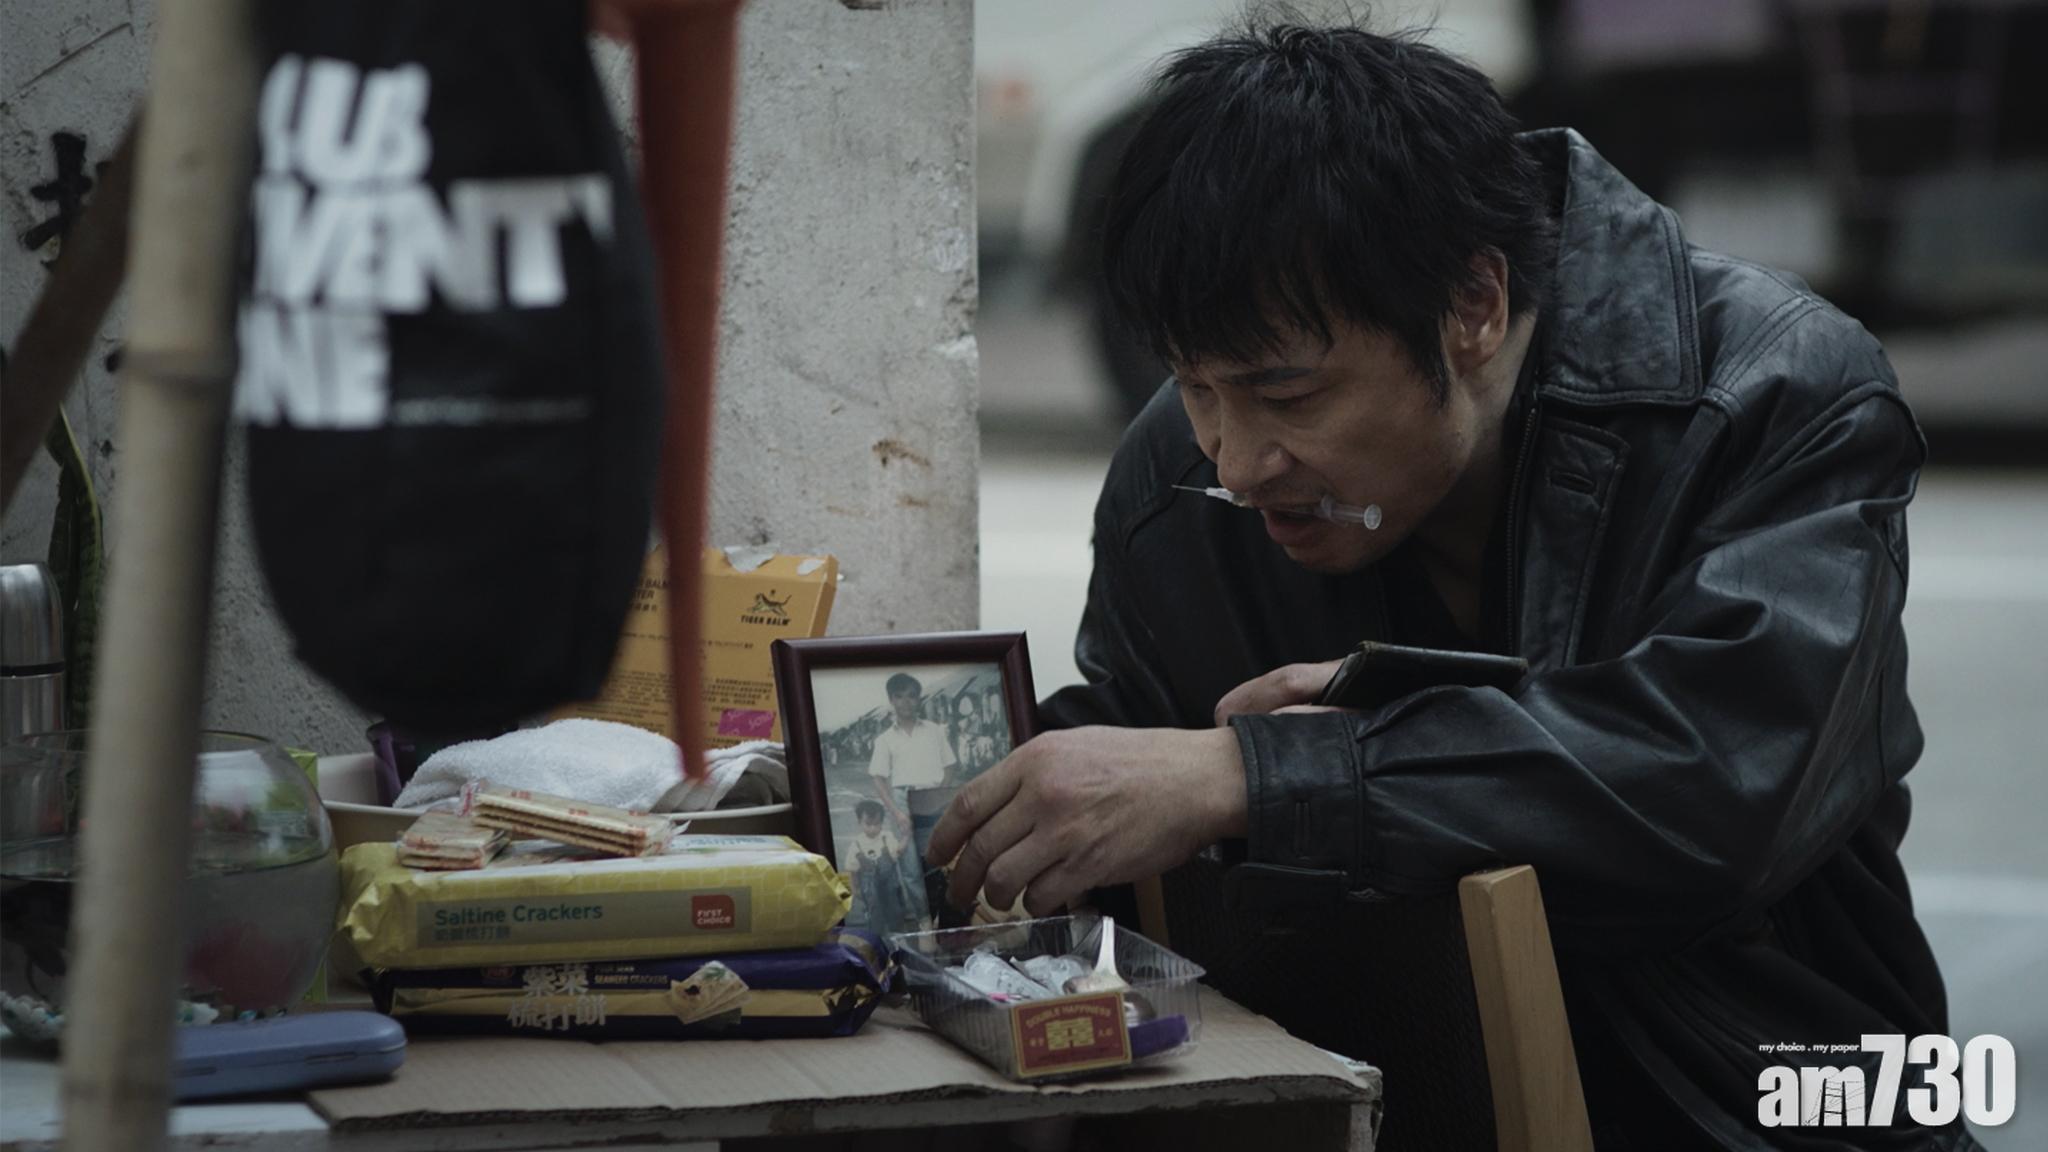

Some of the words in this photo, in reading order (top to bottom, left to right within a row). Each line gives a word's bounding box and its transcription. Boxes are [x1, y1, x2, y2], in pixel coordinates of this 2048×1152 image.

[740, 615, 764, 624] TIGER
[766, 618, 790, 626] BALM
[434, 908, 507, 926] Saltine
[512, 903, 603, 922] Crackers
[697, 909, 722, 917] FIRST
[697, 916, 731, 925] CHOICE
[523, 963, 589, 997] 紫菜
[506, 994, 608, 1031] 梳打餅
[1026, 1008, 1061, 1028] DOUBLE
[1061, 1005, 1112, 1018] HAPPINESS
